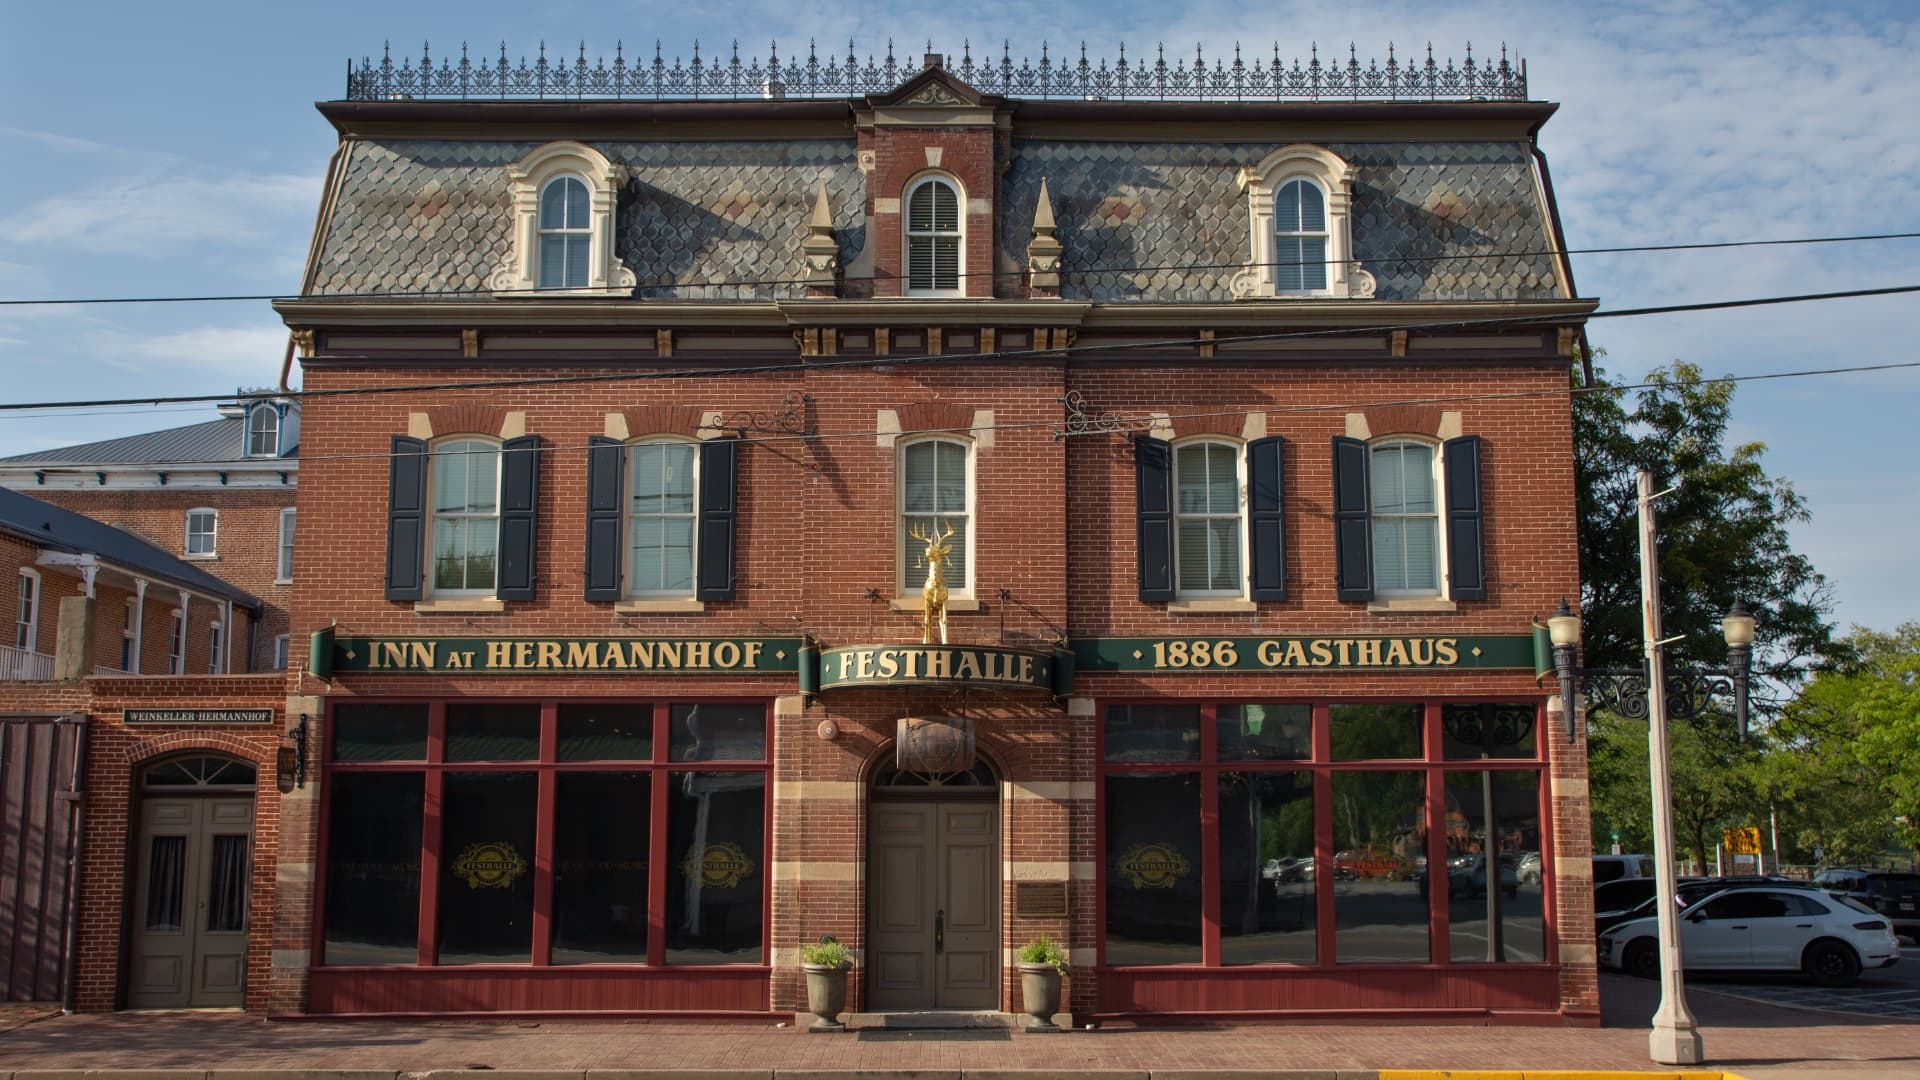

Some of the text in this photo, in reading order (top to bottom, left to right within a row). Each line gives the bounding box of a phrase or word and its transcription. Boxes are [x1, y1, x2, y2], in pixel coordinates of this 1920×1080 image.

[368, 641, 763, 668] INN AT HERMANNHOF
[838, 649, 1035, 683] FESTHALLE
[1152, 638, 1458, 668] 1886 GASTHAUS
[130, 711, 268, 721] WEINKELLER HERMANNHOF
